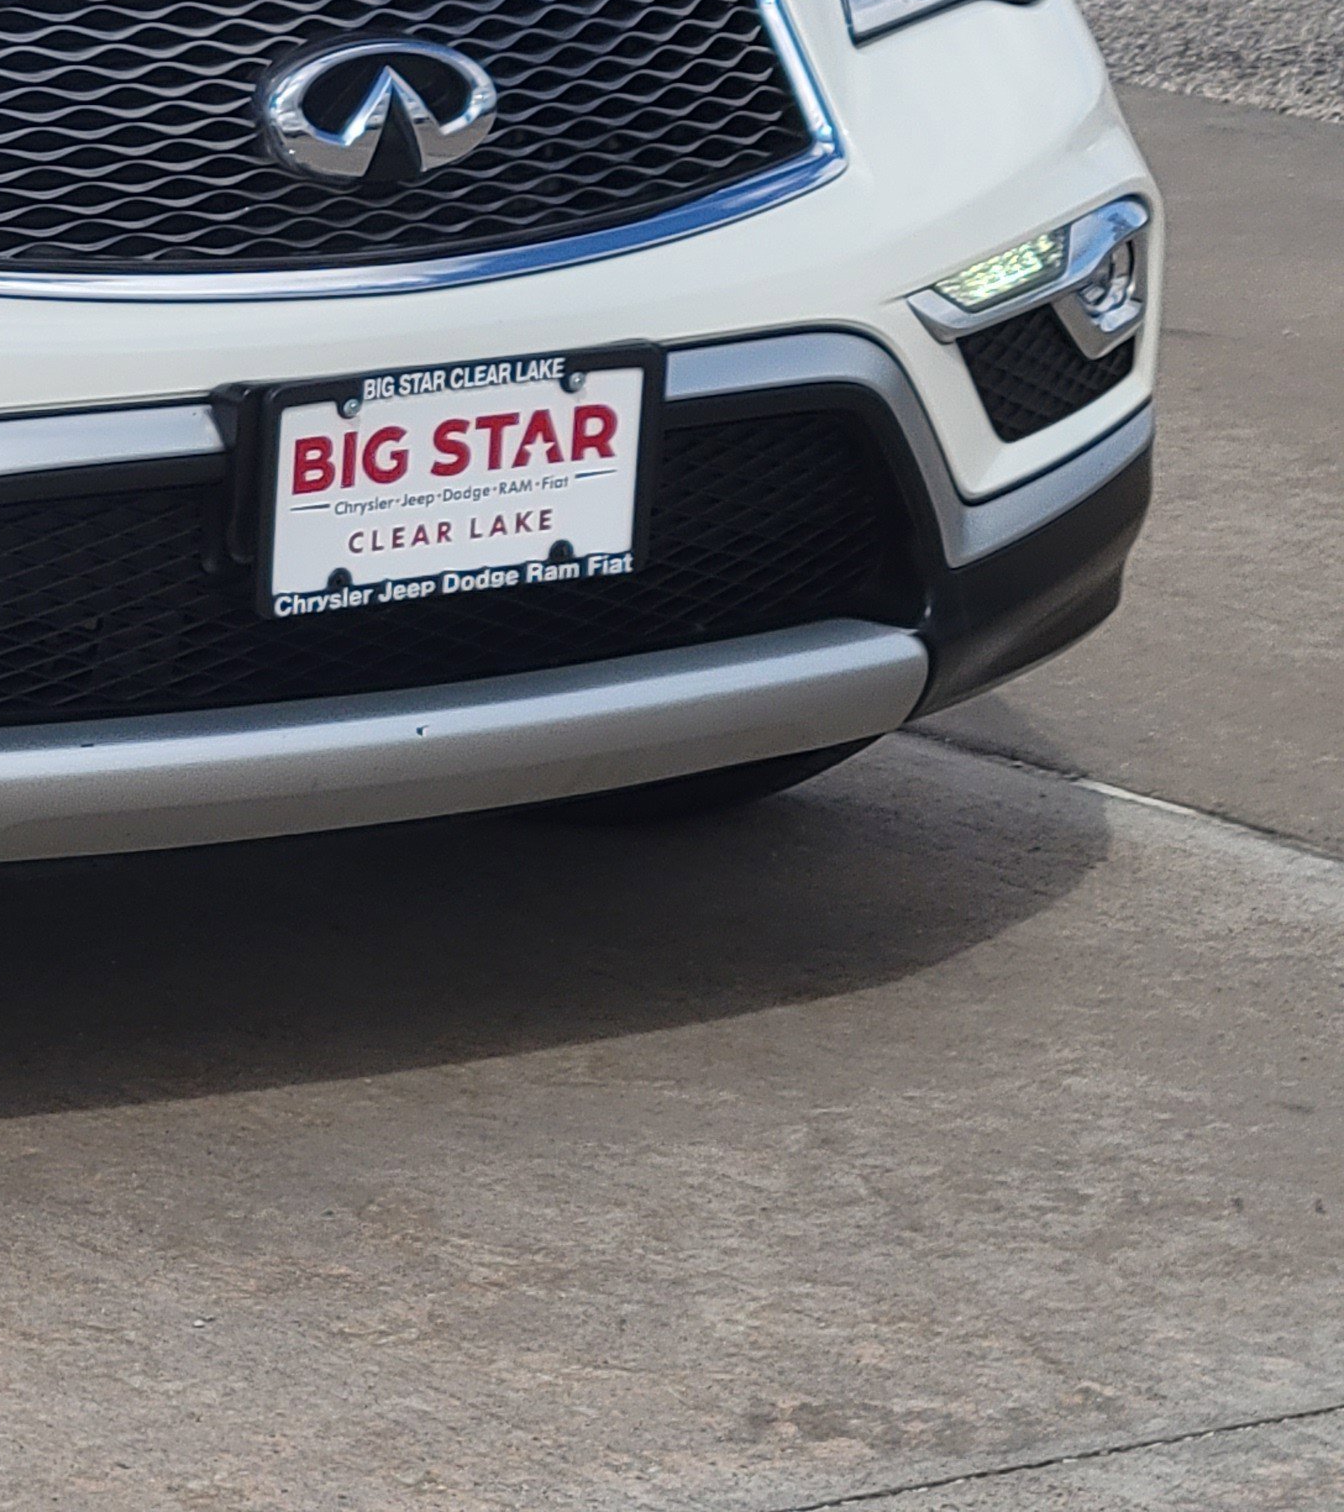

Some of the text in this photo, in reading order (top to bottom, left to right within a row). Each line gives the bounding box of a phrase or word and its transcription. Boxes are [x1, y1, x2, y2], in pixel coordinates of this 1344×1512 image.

[363, 358, 566, 401] BIG STAR CLEAR LAKE
[292, 404, 618, 495] BIG STAR
[348, 509, 554, 554] CLEAR LAKE
[274, 551, 634, 619] Chrysler Jeep Dodge Ram Fiat
